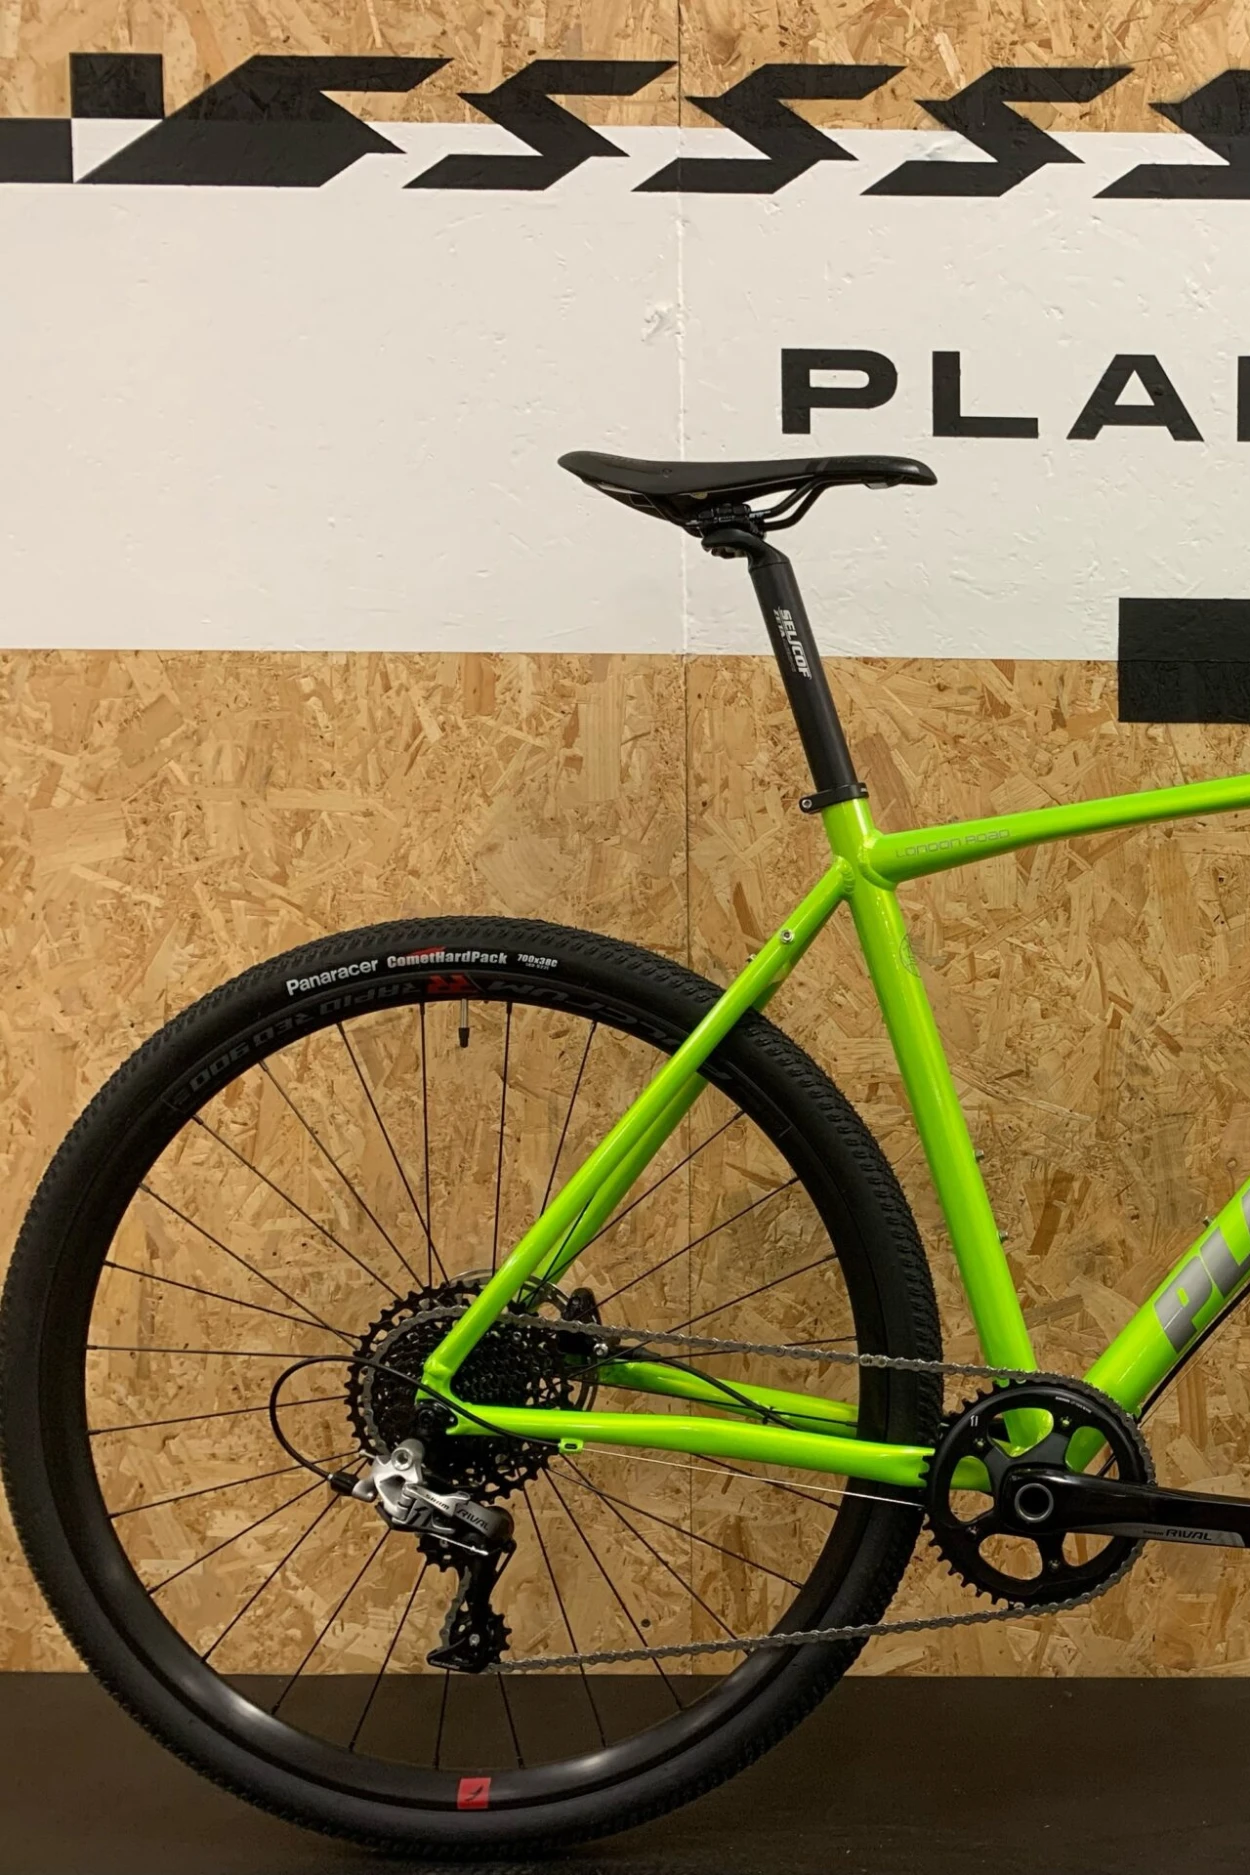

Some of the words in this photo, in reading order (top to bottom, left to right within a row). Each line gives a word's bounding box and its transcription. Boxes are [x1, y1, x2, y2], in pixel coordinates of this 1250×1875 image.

[286, 960, 379, 996] Panaracer
[387, 950, 508, 969] CometHardPack
[457, 1508, 489, 1531] RIVAL
[1165, 1528, 1212, 1541] RIVAL
